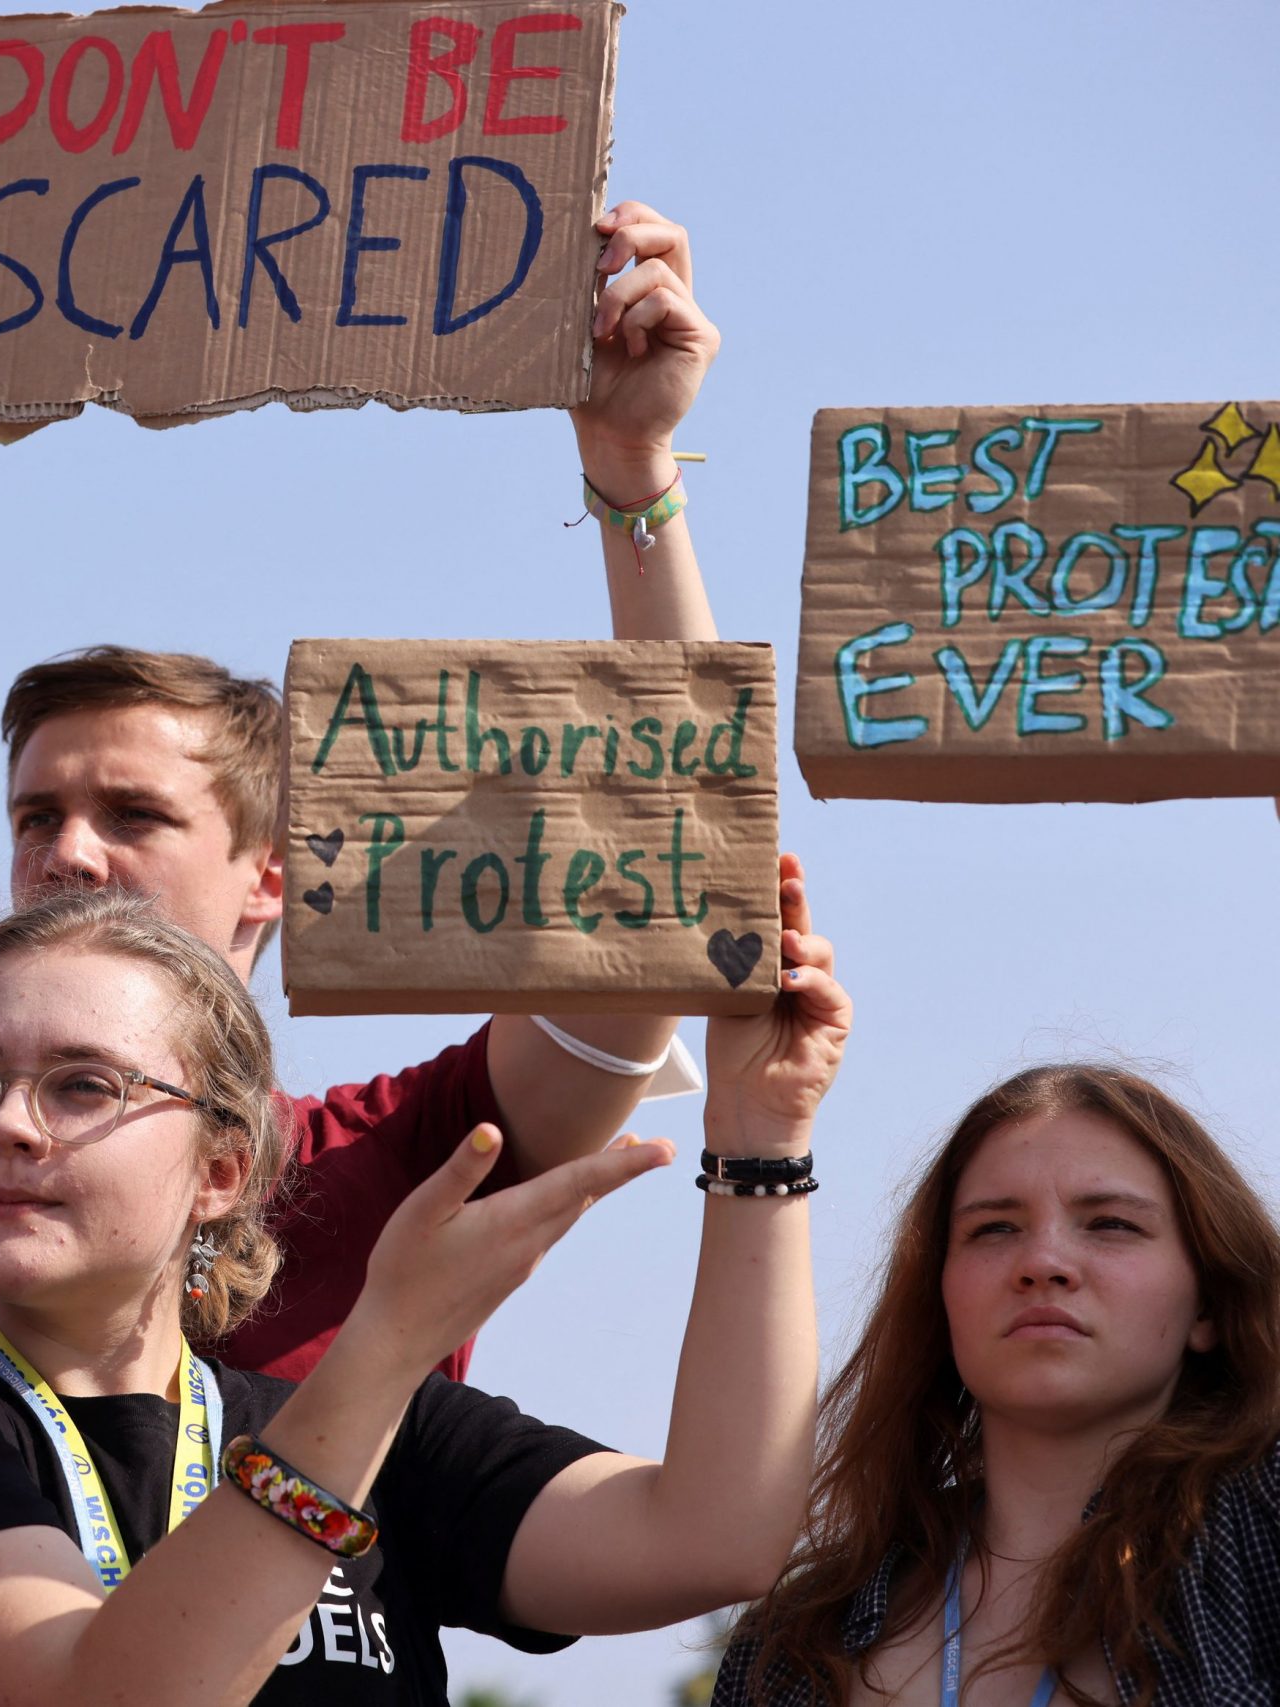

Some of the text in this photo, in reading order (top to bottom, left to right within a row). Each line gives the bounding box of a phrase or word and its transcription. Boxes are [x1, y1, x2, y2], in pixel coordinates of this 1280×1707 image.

[400, 14, 583, 145] BE
[838, 416, 1103, 532] BEST
[310, 661, 758, 780] Authorised
[835, 621, 1175, 749] EVER
[357, 807, 710, 934] Protest
